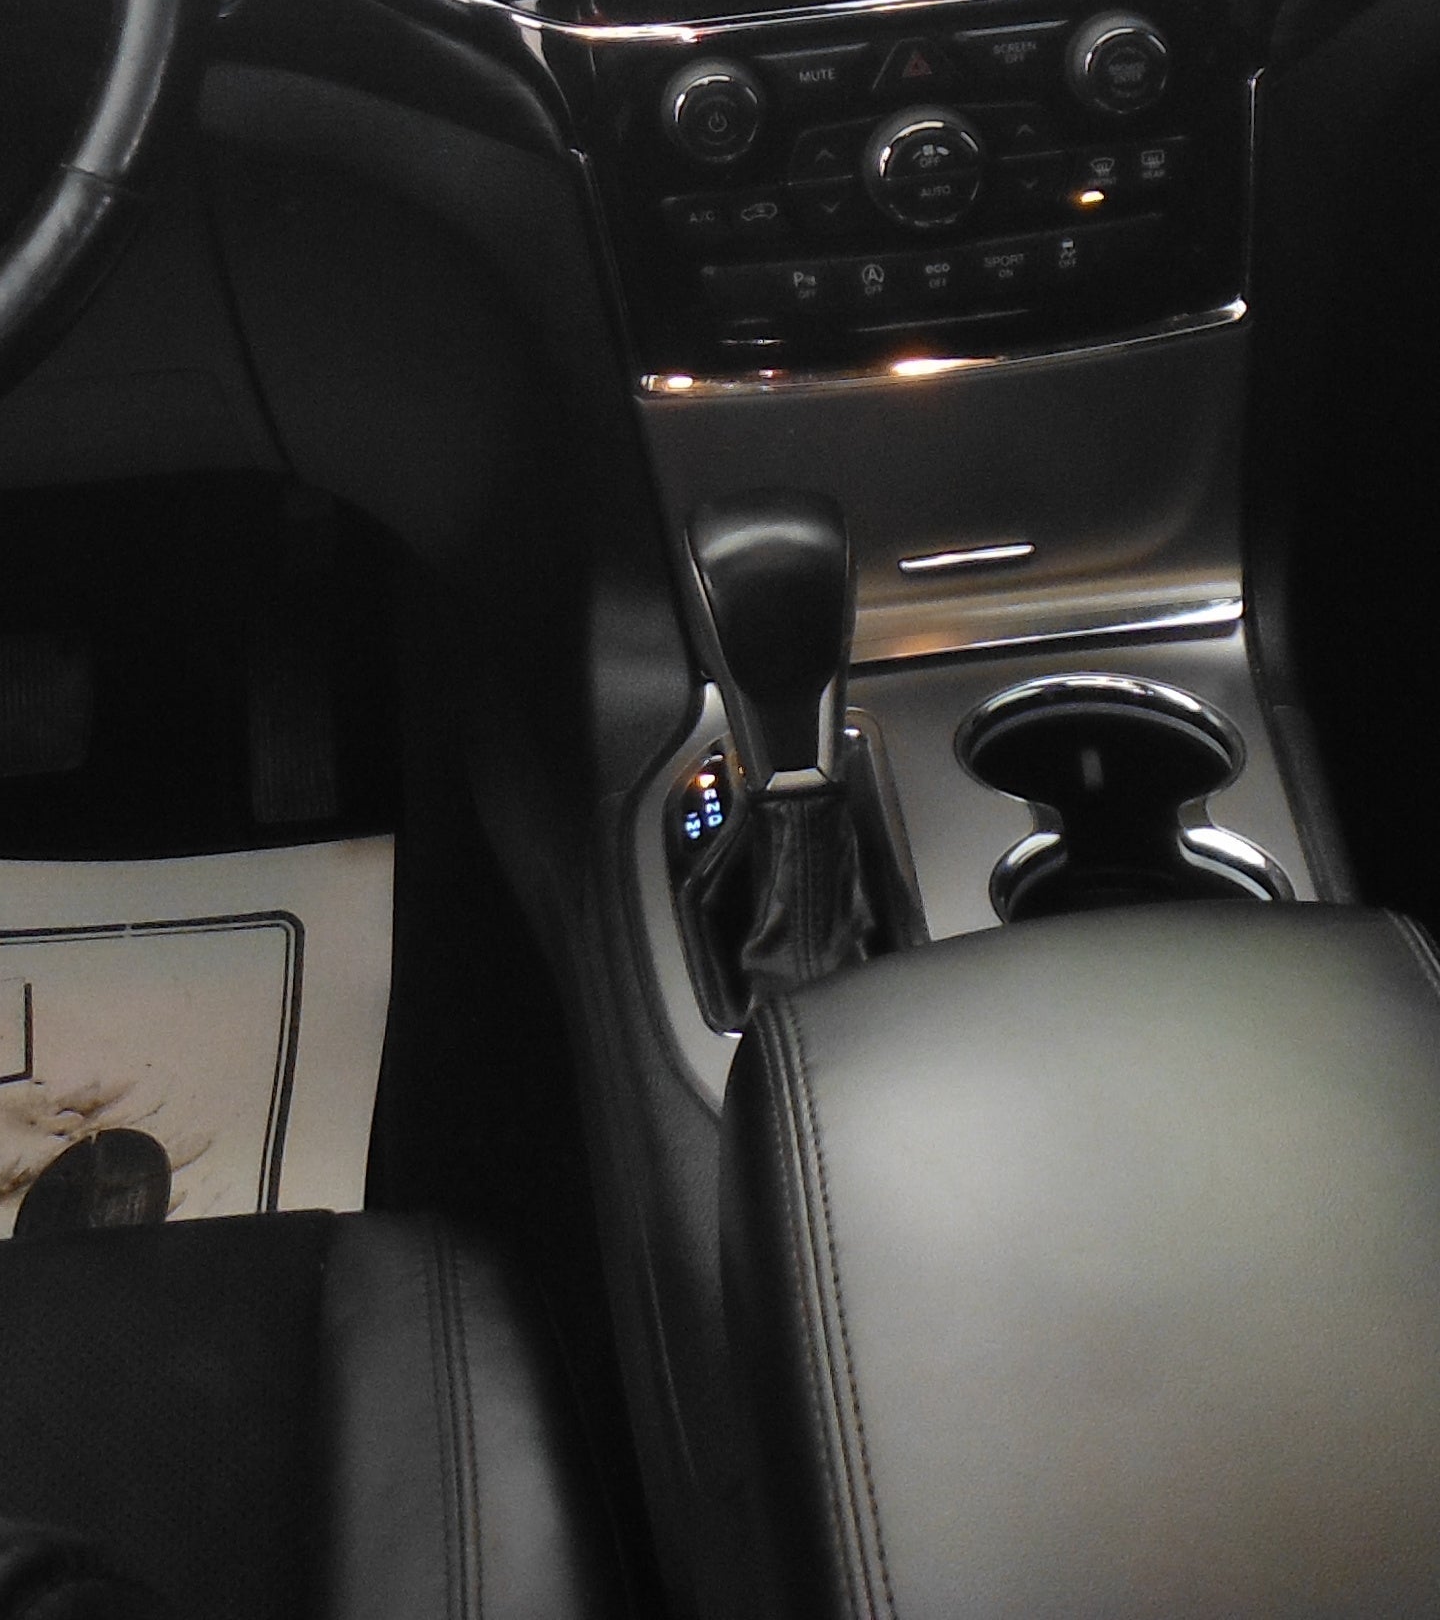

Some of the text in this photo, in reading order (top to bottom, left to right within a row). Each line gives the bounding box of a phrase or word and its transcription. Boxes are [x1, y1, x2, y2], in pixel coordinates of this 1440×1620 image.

[798, 67, 837, 84] MUTE
[919, 156, 941, 169] OFF
[920, 185, 951, 198] AUTO
[689, 209, 716, 223] A/C
[983, 253, 1025, 269] SPORT
[1059, 257, 1077, 269] OFF
